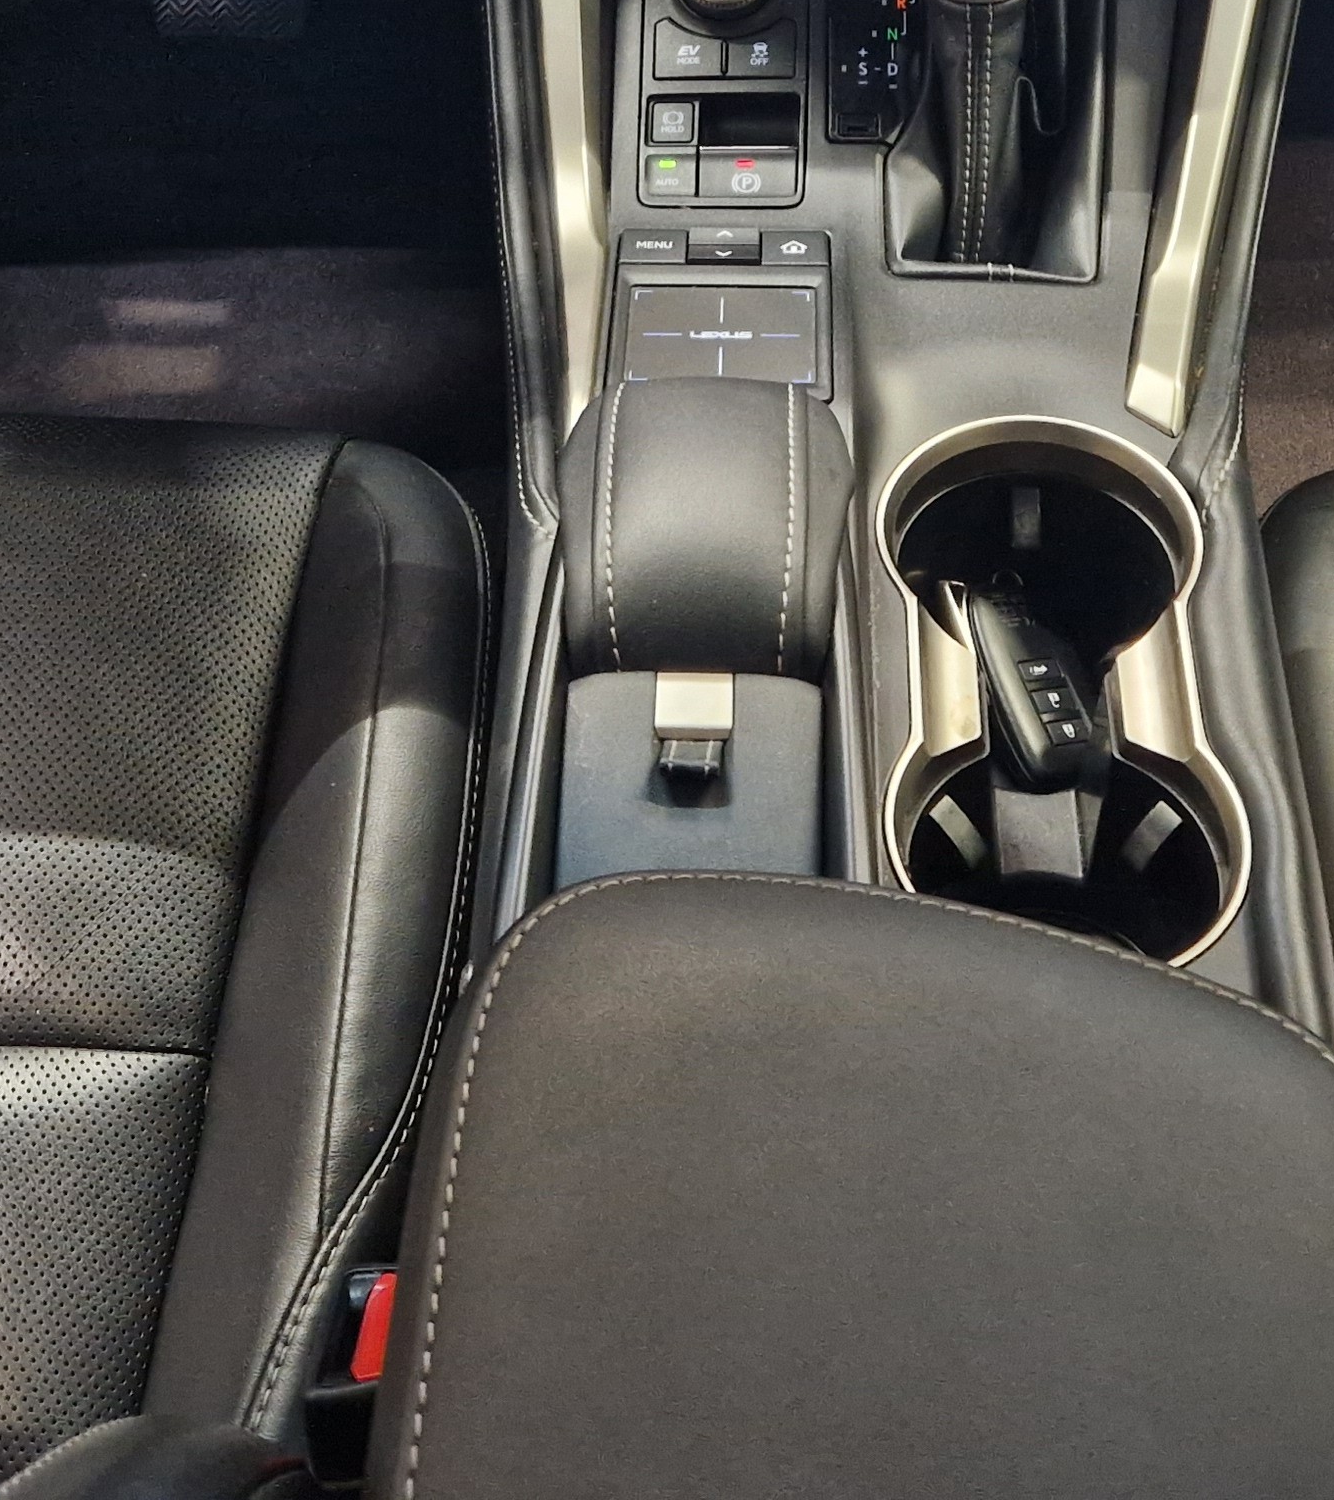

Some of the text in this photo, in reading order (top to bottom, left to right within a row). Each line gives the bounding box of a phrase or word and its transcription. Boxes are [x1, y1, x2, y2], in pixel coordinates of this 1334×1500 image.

[887, 27, 898, 41] N
[677, 45, 701, 56] EV
[676, 56, 701, 65] MODE
[750, 57, 769, 66] OFF
[858, 61, 868, 76] S
[887, 62, 898, 77] D
[660, 124, 685, 133] HOLD
[655, 177, 679, 186] AUTO
[635, 240, 673, 250] MENU
[689, 330, 753, 339] LEXUS
